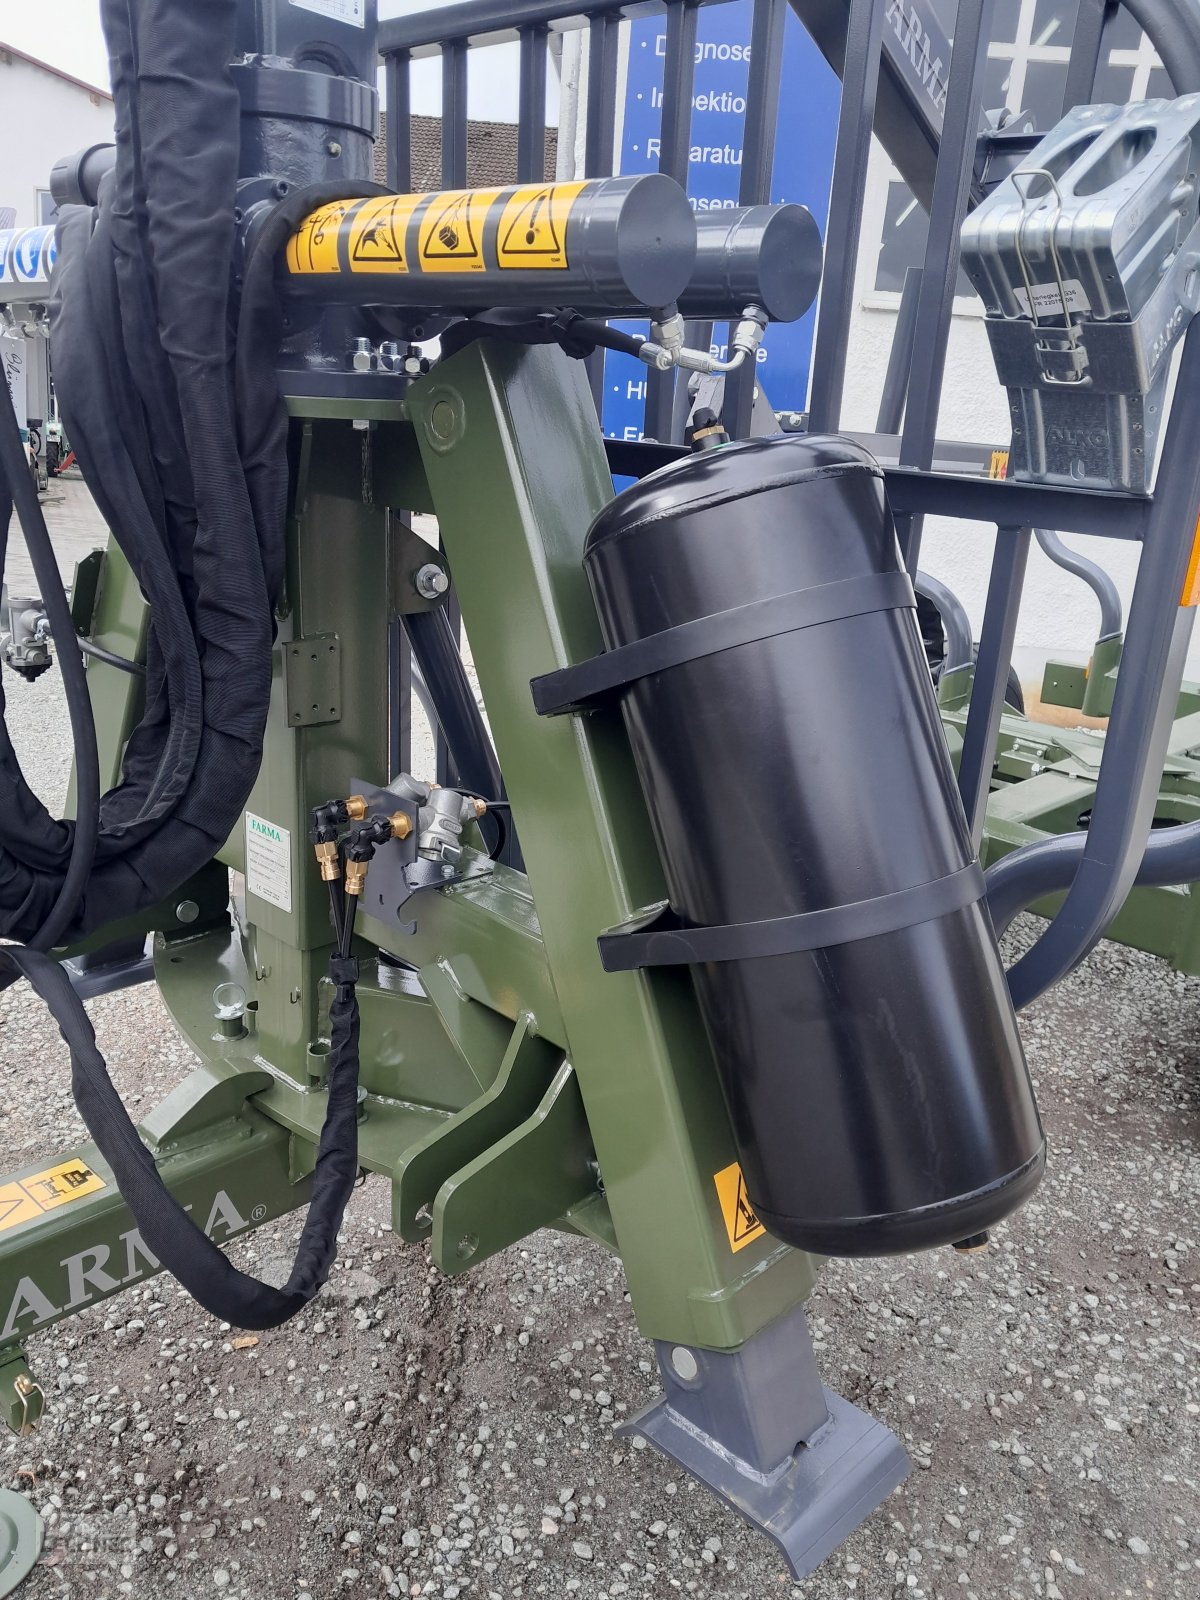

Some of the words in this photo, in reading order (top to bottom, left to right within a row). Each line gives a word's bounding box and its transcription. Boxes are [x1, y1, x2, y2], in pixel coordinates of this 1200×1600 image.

[655, 34, 751, 64] Dgnose
[651, 86, 746, 114] Iektio
[646, 138, 742, 165] Raratu
[251, 819, 281, 842] FARMA
